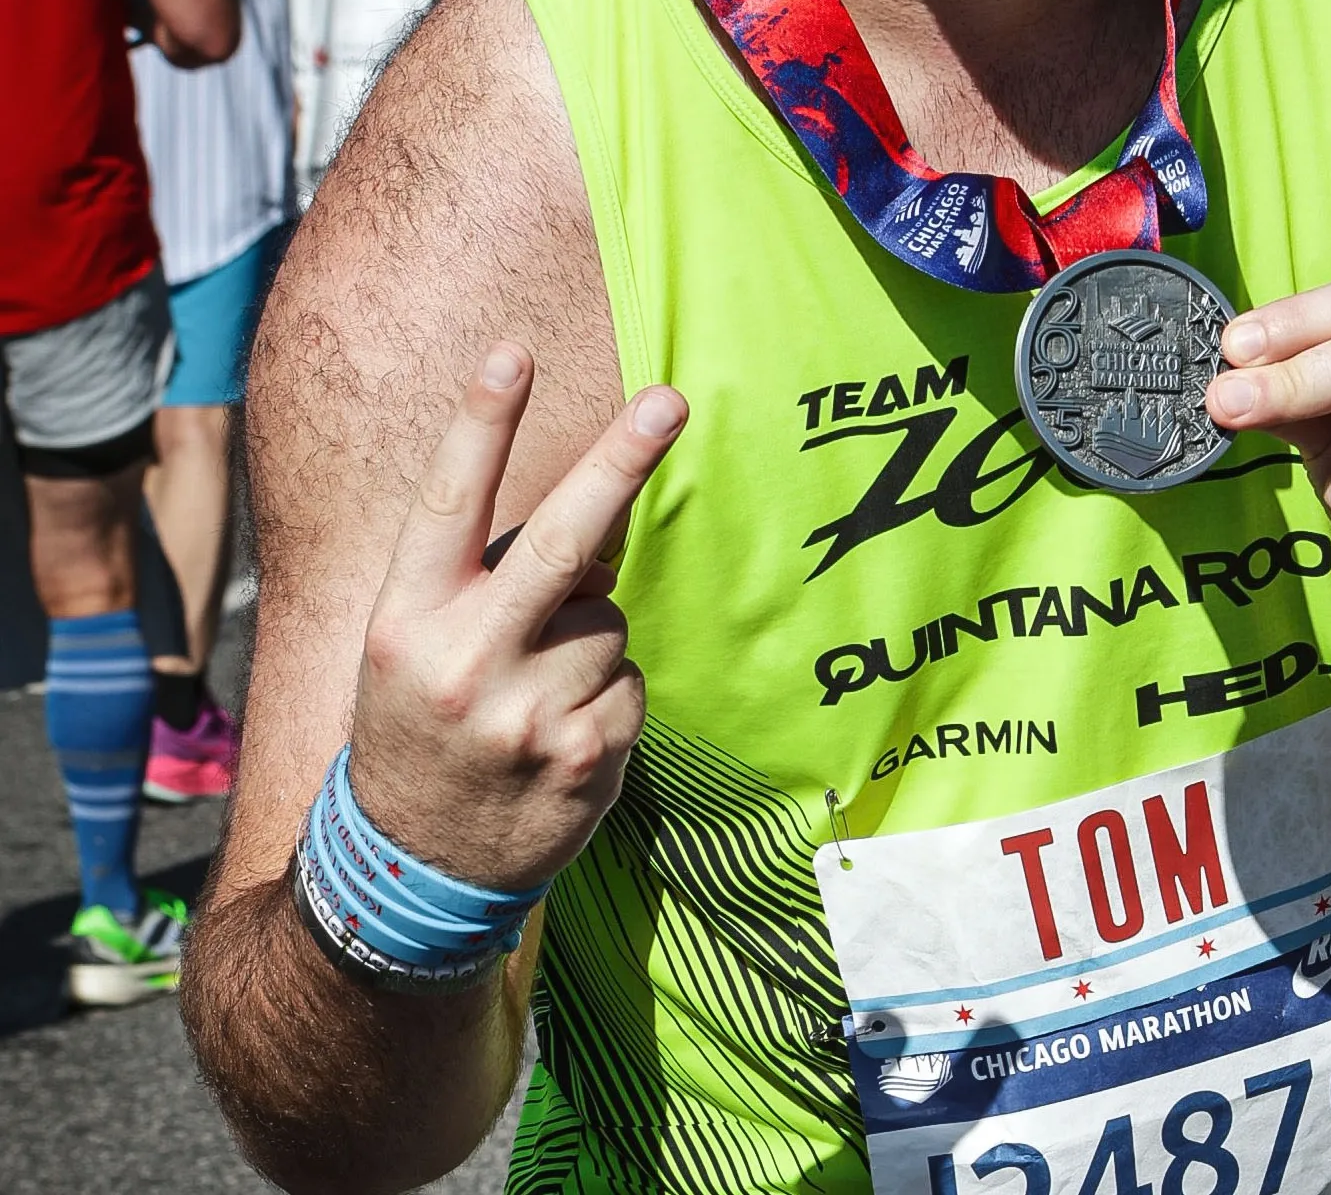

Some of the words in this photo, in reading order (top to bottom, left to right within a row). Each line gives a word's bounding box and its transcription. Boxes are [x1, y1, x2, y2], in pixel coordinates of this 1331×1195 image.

[898, 227, 917, 244] BANK
[924, 183, 949, 218] AMERICA
[907, 183, 960, 252] CHICAGO
[921, 185, 969, 259] MARATHON
[797, 355, 970, 430] TEAM
[1091, 351, 1181, 373] CHICAGO
[1091, 371, 1181, 390] MARATHON
[813, 564, 1180, 706] QUINTANA
[870, 719, 1058, 782] GARMIN
[337, 824, 377, 882] Keep
[999, 780, 1229, 962] TOM
[338, 867, 383, 916] Keep
[970, 1033, 1090, 1082] CHICAGO
[1100, 986, 1252, 1054] MARATHON
